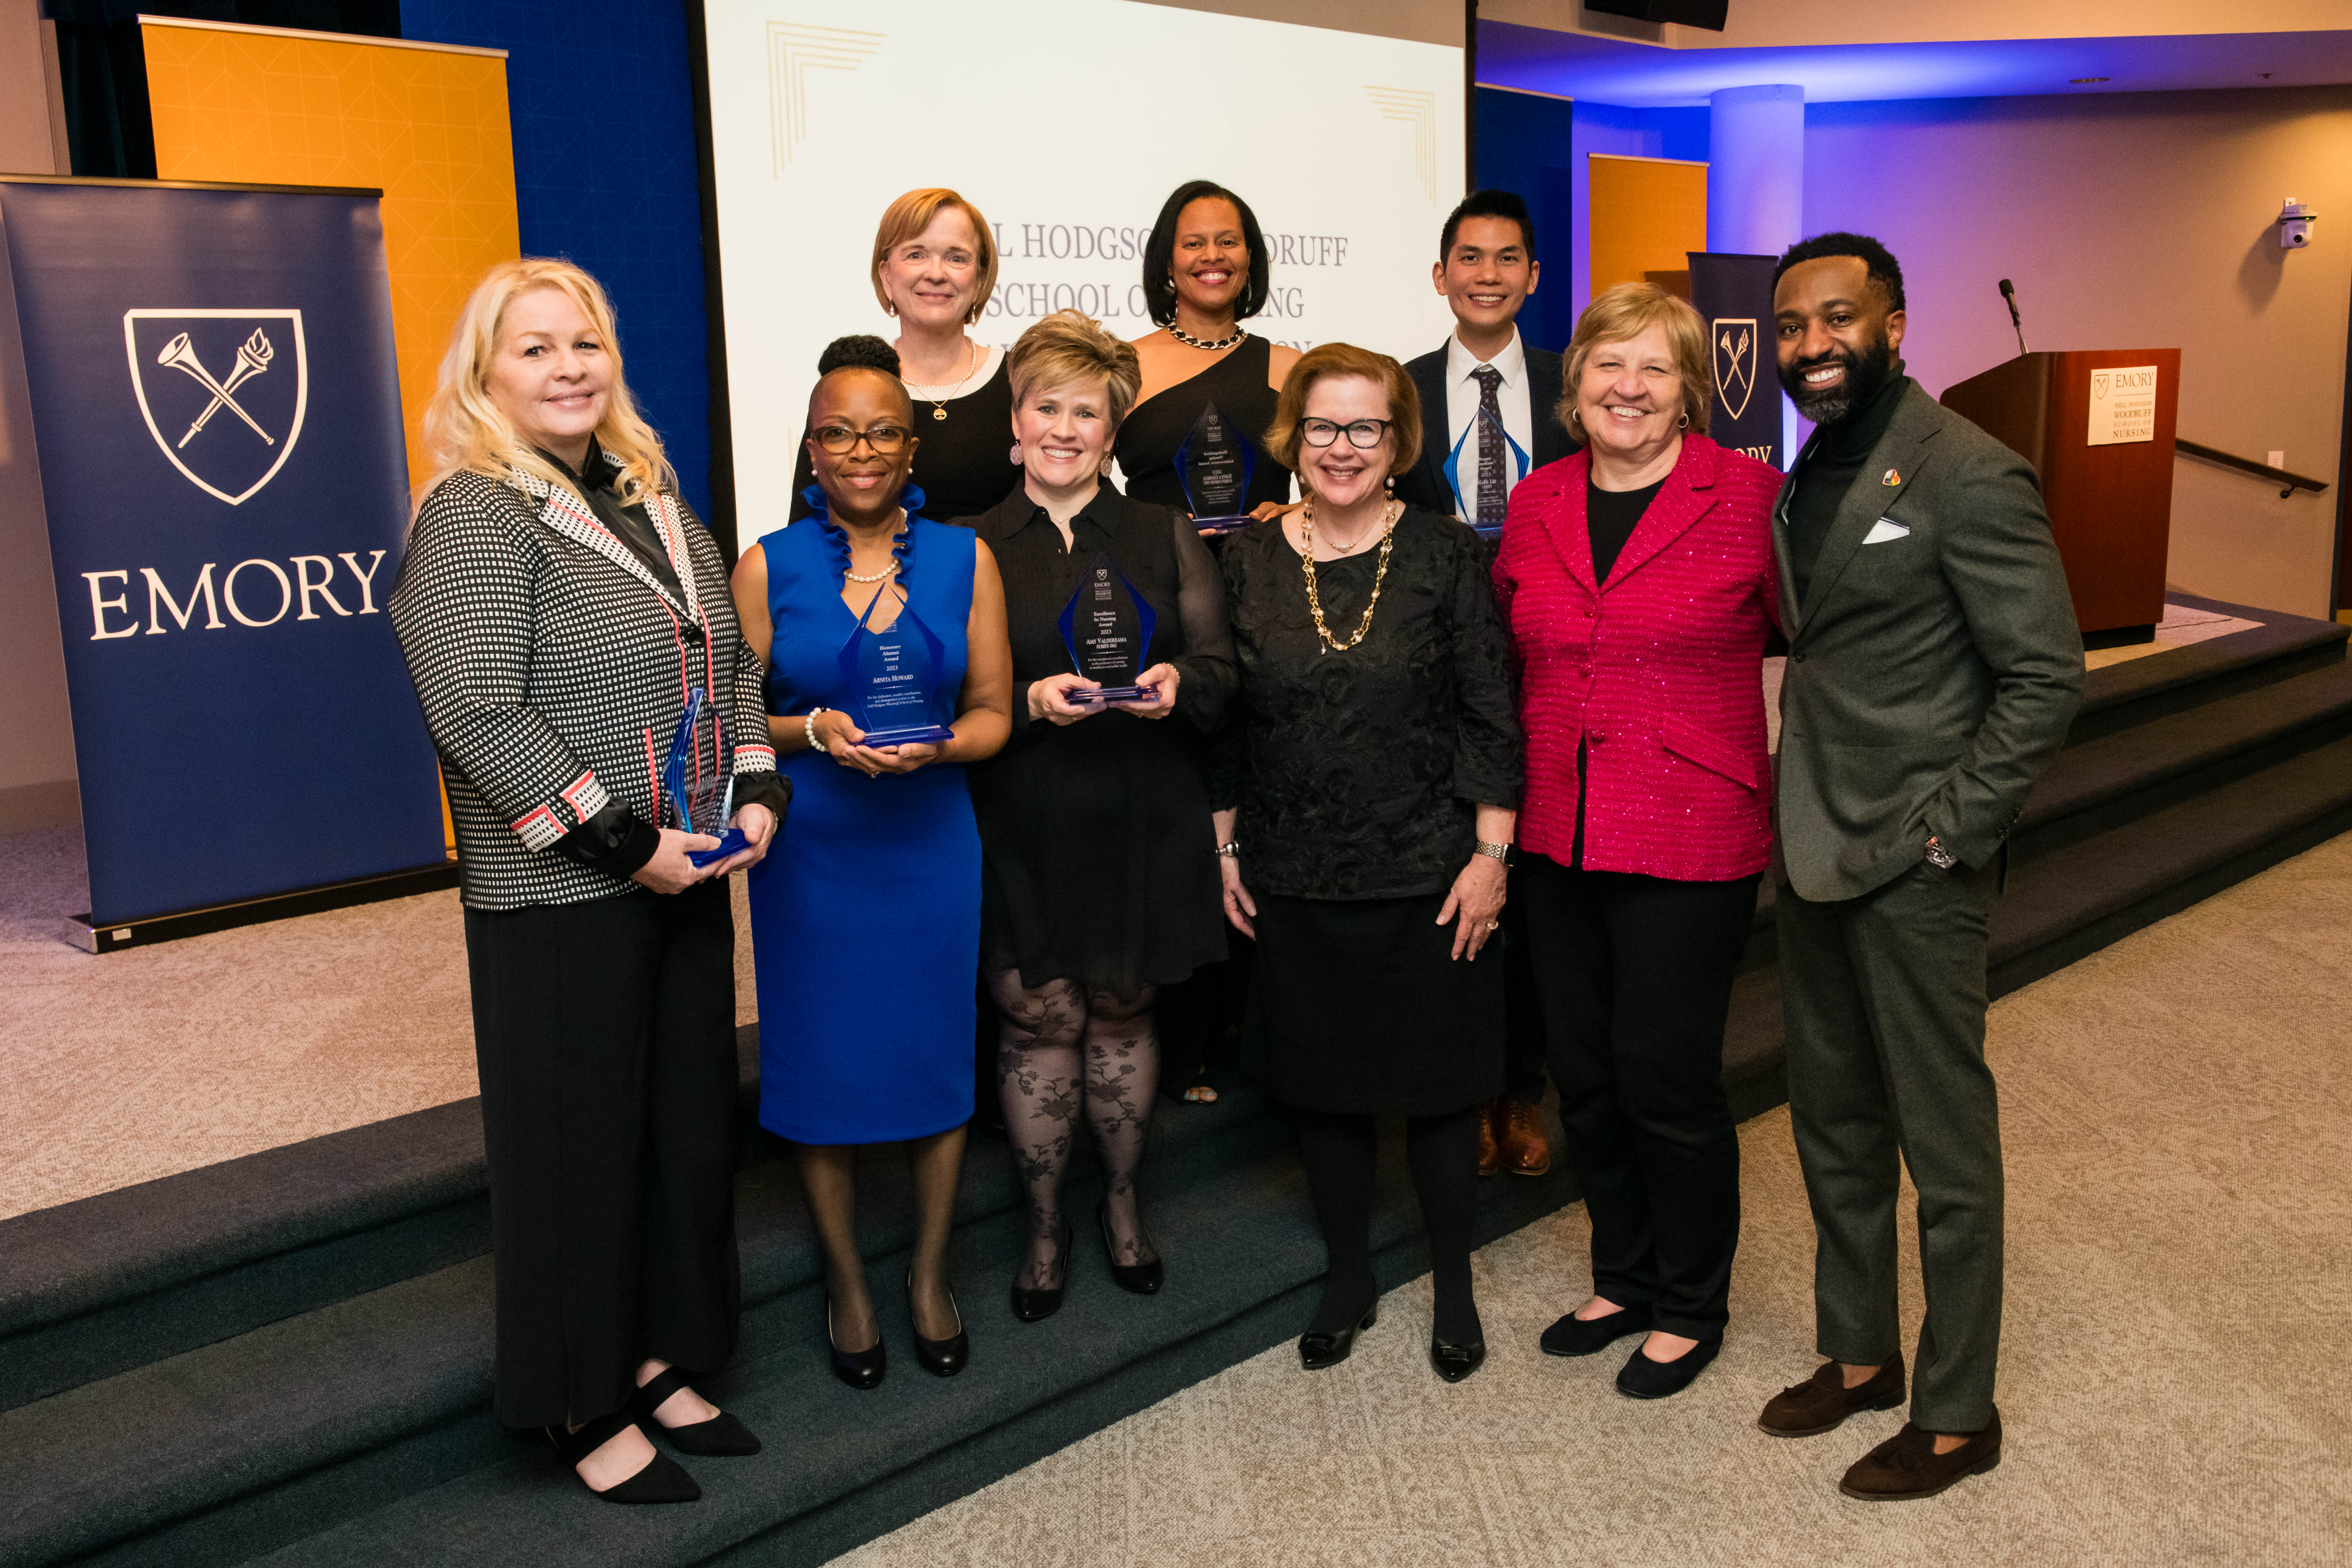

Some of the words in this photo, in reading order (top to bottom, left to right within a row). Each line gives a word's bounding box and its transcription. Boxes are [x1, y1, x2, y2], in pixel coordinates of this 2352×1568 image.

[1021, 224, 1152, 260] HODGSO
[985, 283, 1120, 318] SCHOOL
[2116, 372, 2154, 388] EMORY
[2114, 409, 2152, 419] WOODRUFF
[2113, 428, 2151, 438] NURSING
[81, 550, 386, 640] EMORY
